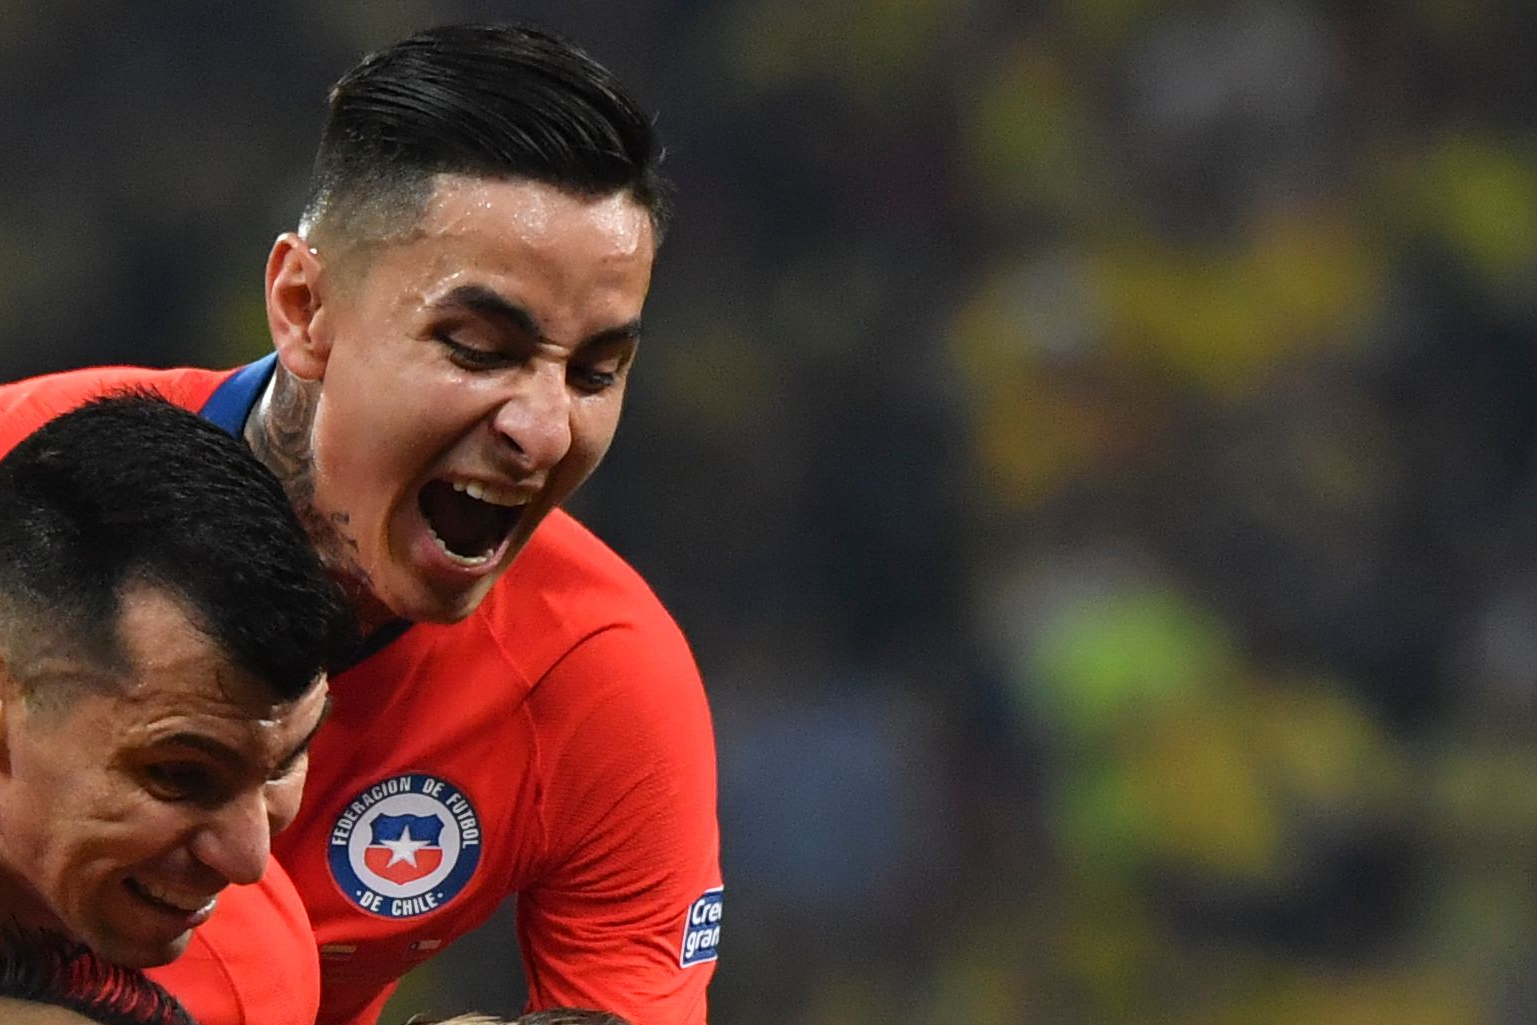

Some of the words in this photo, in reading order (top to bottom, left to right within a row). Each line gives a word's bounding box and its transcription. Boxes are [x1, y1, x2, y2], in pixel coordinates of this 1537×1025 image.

[331, 775, 411, 846] FEDERACION
[421, 777, 446, 798] DE
[445, 792, 479, 849] FUTBOL
[358, 891, 384, 913] DE
[391, 892, 439, 916] CHILE
